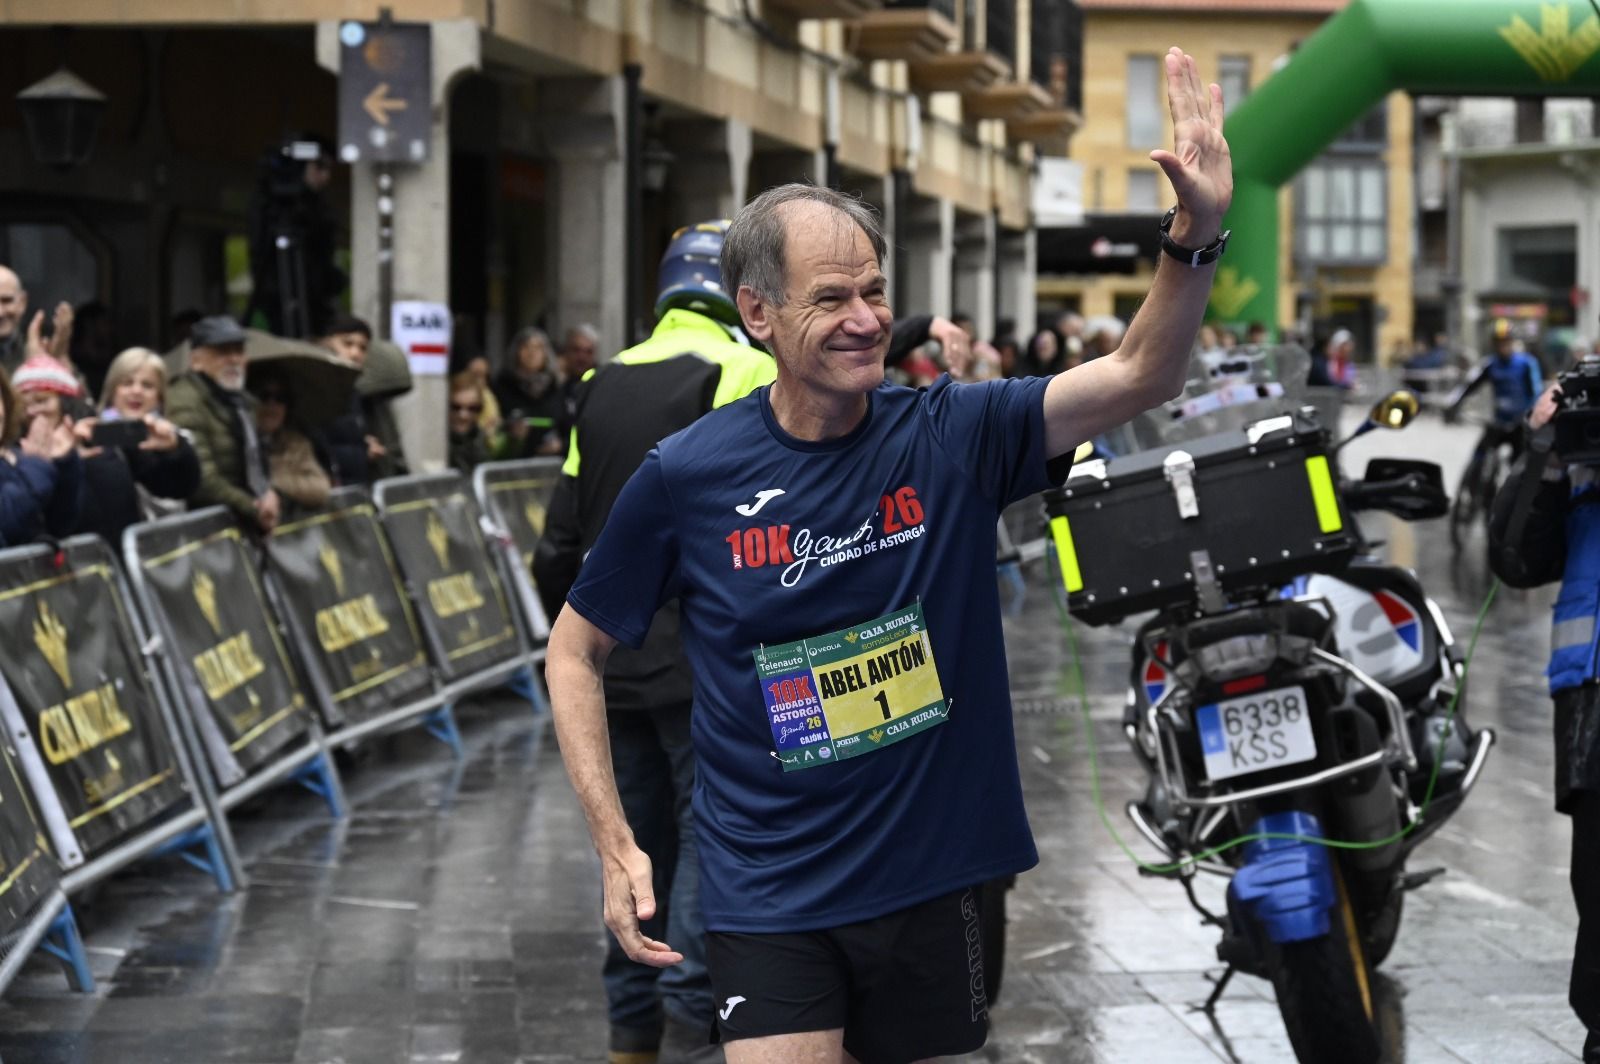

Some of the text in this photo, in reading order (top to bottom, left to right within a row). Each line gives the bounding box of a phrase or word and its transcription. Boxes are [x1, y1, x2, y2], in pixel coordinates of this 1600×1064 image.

[726, 524, 795, 568] 10K
[820, 524, 926, 567] CIUDAD DE ASTORGA
[859, 613, 918, 640] CAJA RURAL
[818, 643, 842, 653] VEOLIA
[760, 657, 803, 671] Telenauto
[819, 640, 925, 699] ABEL ANTÓN
[768, 675, 813, 705] 10K
[770, 696, 818, 713] CIUDAD DE
[873, 689, 892, 720] 1
[773, 705, 822, 724] ASTORGA
[806, 715, 822, 730] 26
[887, 707, 942, 736] CAJA RURAL
[1224, 694, 1302, 736] 6338
[822, 731, 829, 740] A
[1229, 730, 1288, 768] KSS
